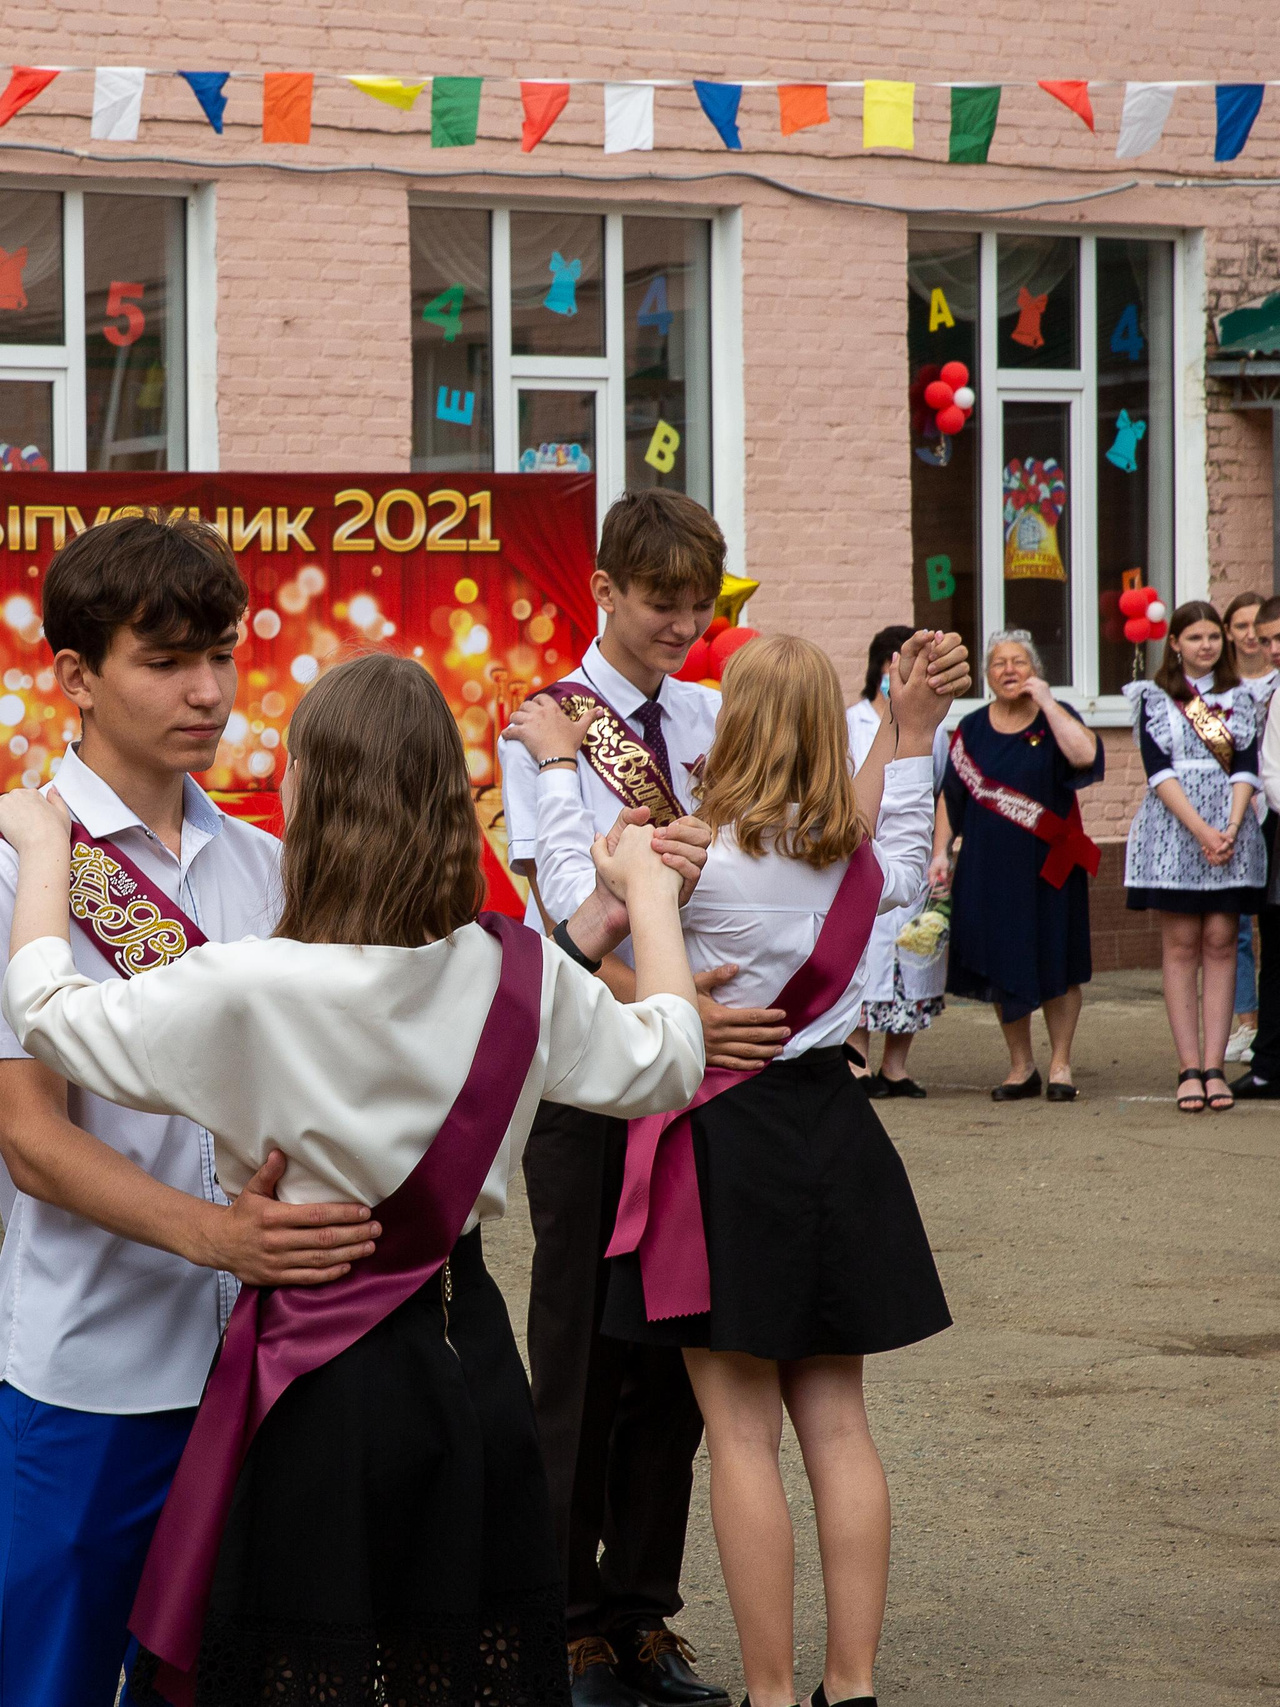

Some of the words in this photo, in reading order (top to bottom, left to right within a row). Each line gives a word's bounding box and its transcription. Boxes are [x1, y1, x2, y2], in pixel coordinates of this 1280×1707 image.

[103, 281, 146, 346] 5
[422, 282, 466, 342] 4
[637, 275, 673, 335] 4
[929, 288, 955, 332] А
[1110, 304, 1144, 361] 4
[644, 419, 680, 474] В
[332, 488, 501, 552] 2021
[925, 554, 957, 601] В
